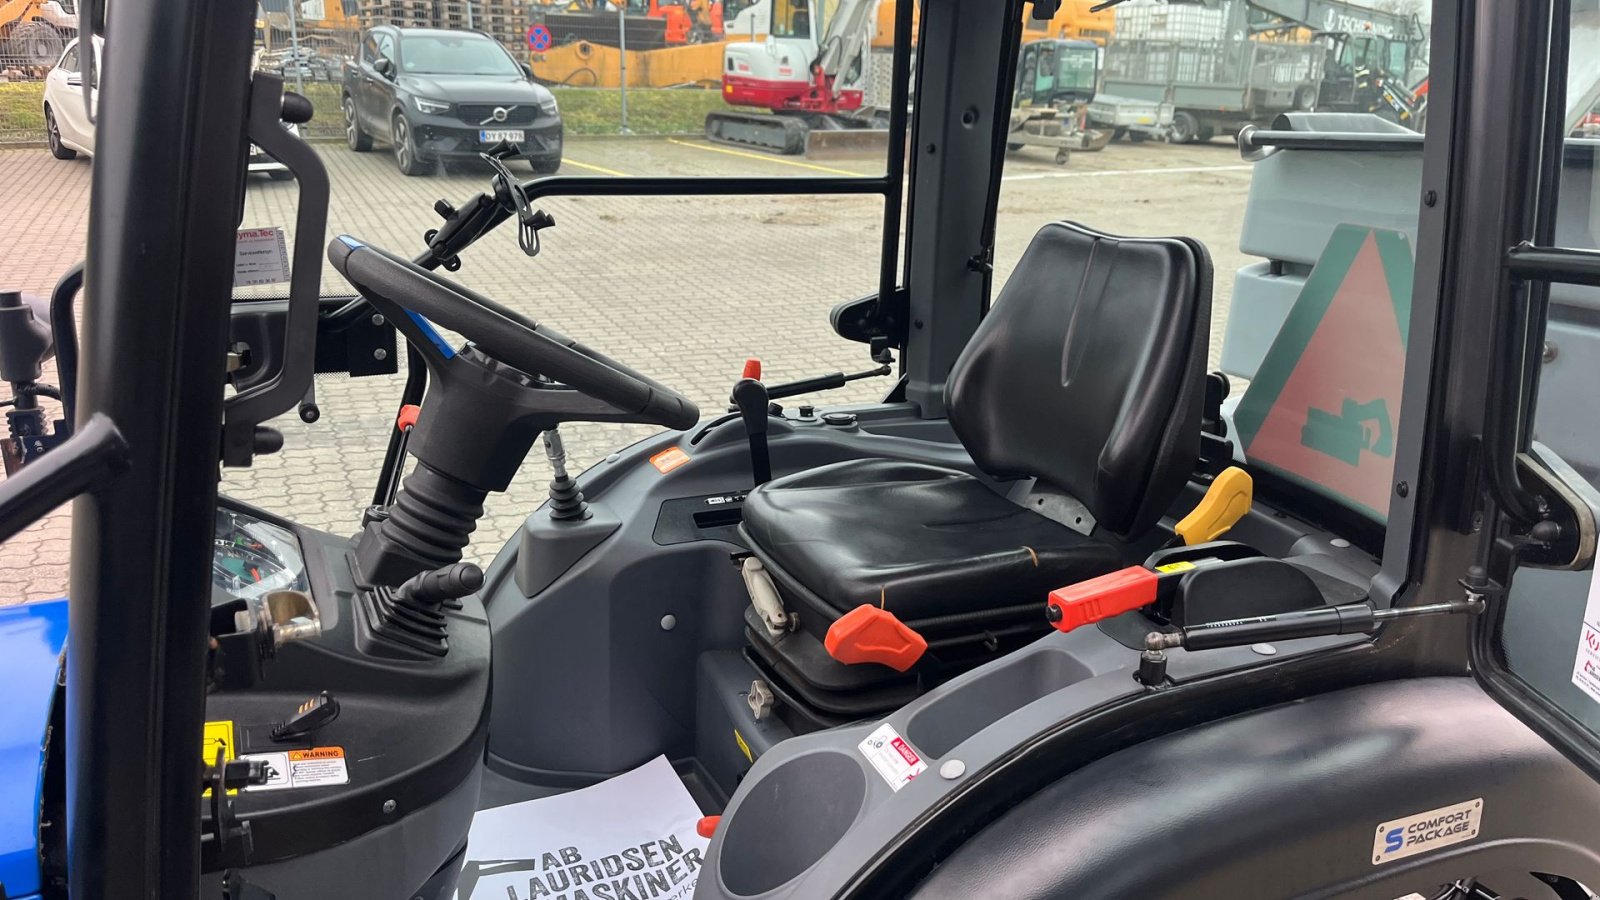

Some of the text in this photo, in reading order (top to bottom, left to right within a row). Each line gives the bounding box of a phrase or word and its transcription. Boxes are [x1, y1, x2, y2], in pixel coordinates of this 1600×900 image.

[237, 230, 274, 240] yma.Tec
[302, 750, 339, 758] WARNING
[897, 743, 918, 765] DANGER
[1406, 821, 1470, 847] PACKAGE
[1407, 809, 1472, 834] COMFORT
[1383, 826, 1405, 854] S
[542, 846, 582, 871] AB
